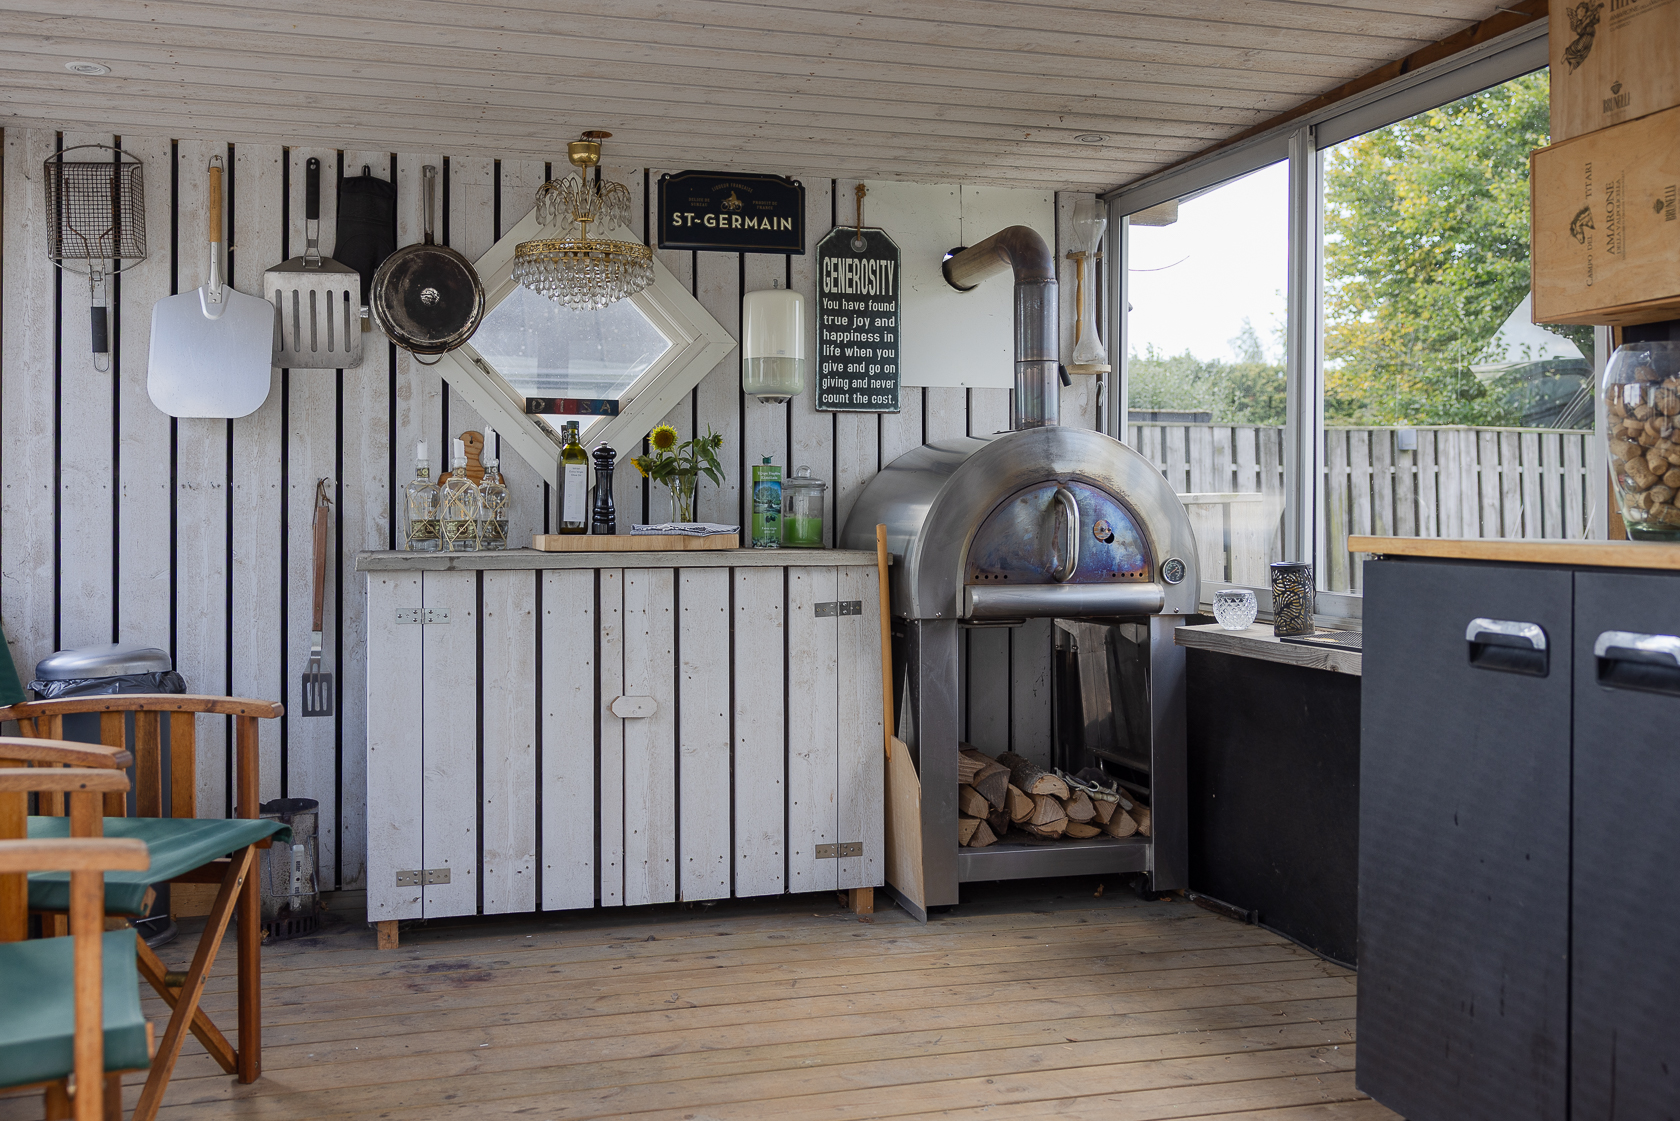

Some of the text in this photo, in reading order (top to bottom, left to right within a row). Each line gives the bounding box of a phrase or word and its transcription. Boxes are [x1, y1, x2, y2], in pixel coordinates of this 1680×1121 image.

[1605, 180, 1615, 255] AMARONE
[823, 256, 895, 296] GENEROSITY
[822, 297, 895, 312] You have found
[823, 314, 895, 329] true joy and
[823, 328, 894, 344] happiness in
[823, 344, 895, 361] life when you
[822, 360, 896, 376] give and go on
[822, 375, 896, 390] giving and never
[822, 392, 895, 404] count the cost.
